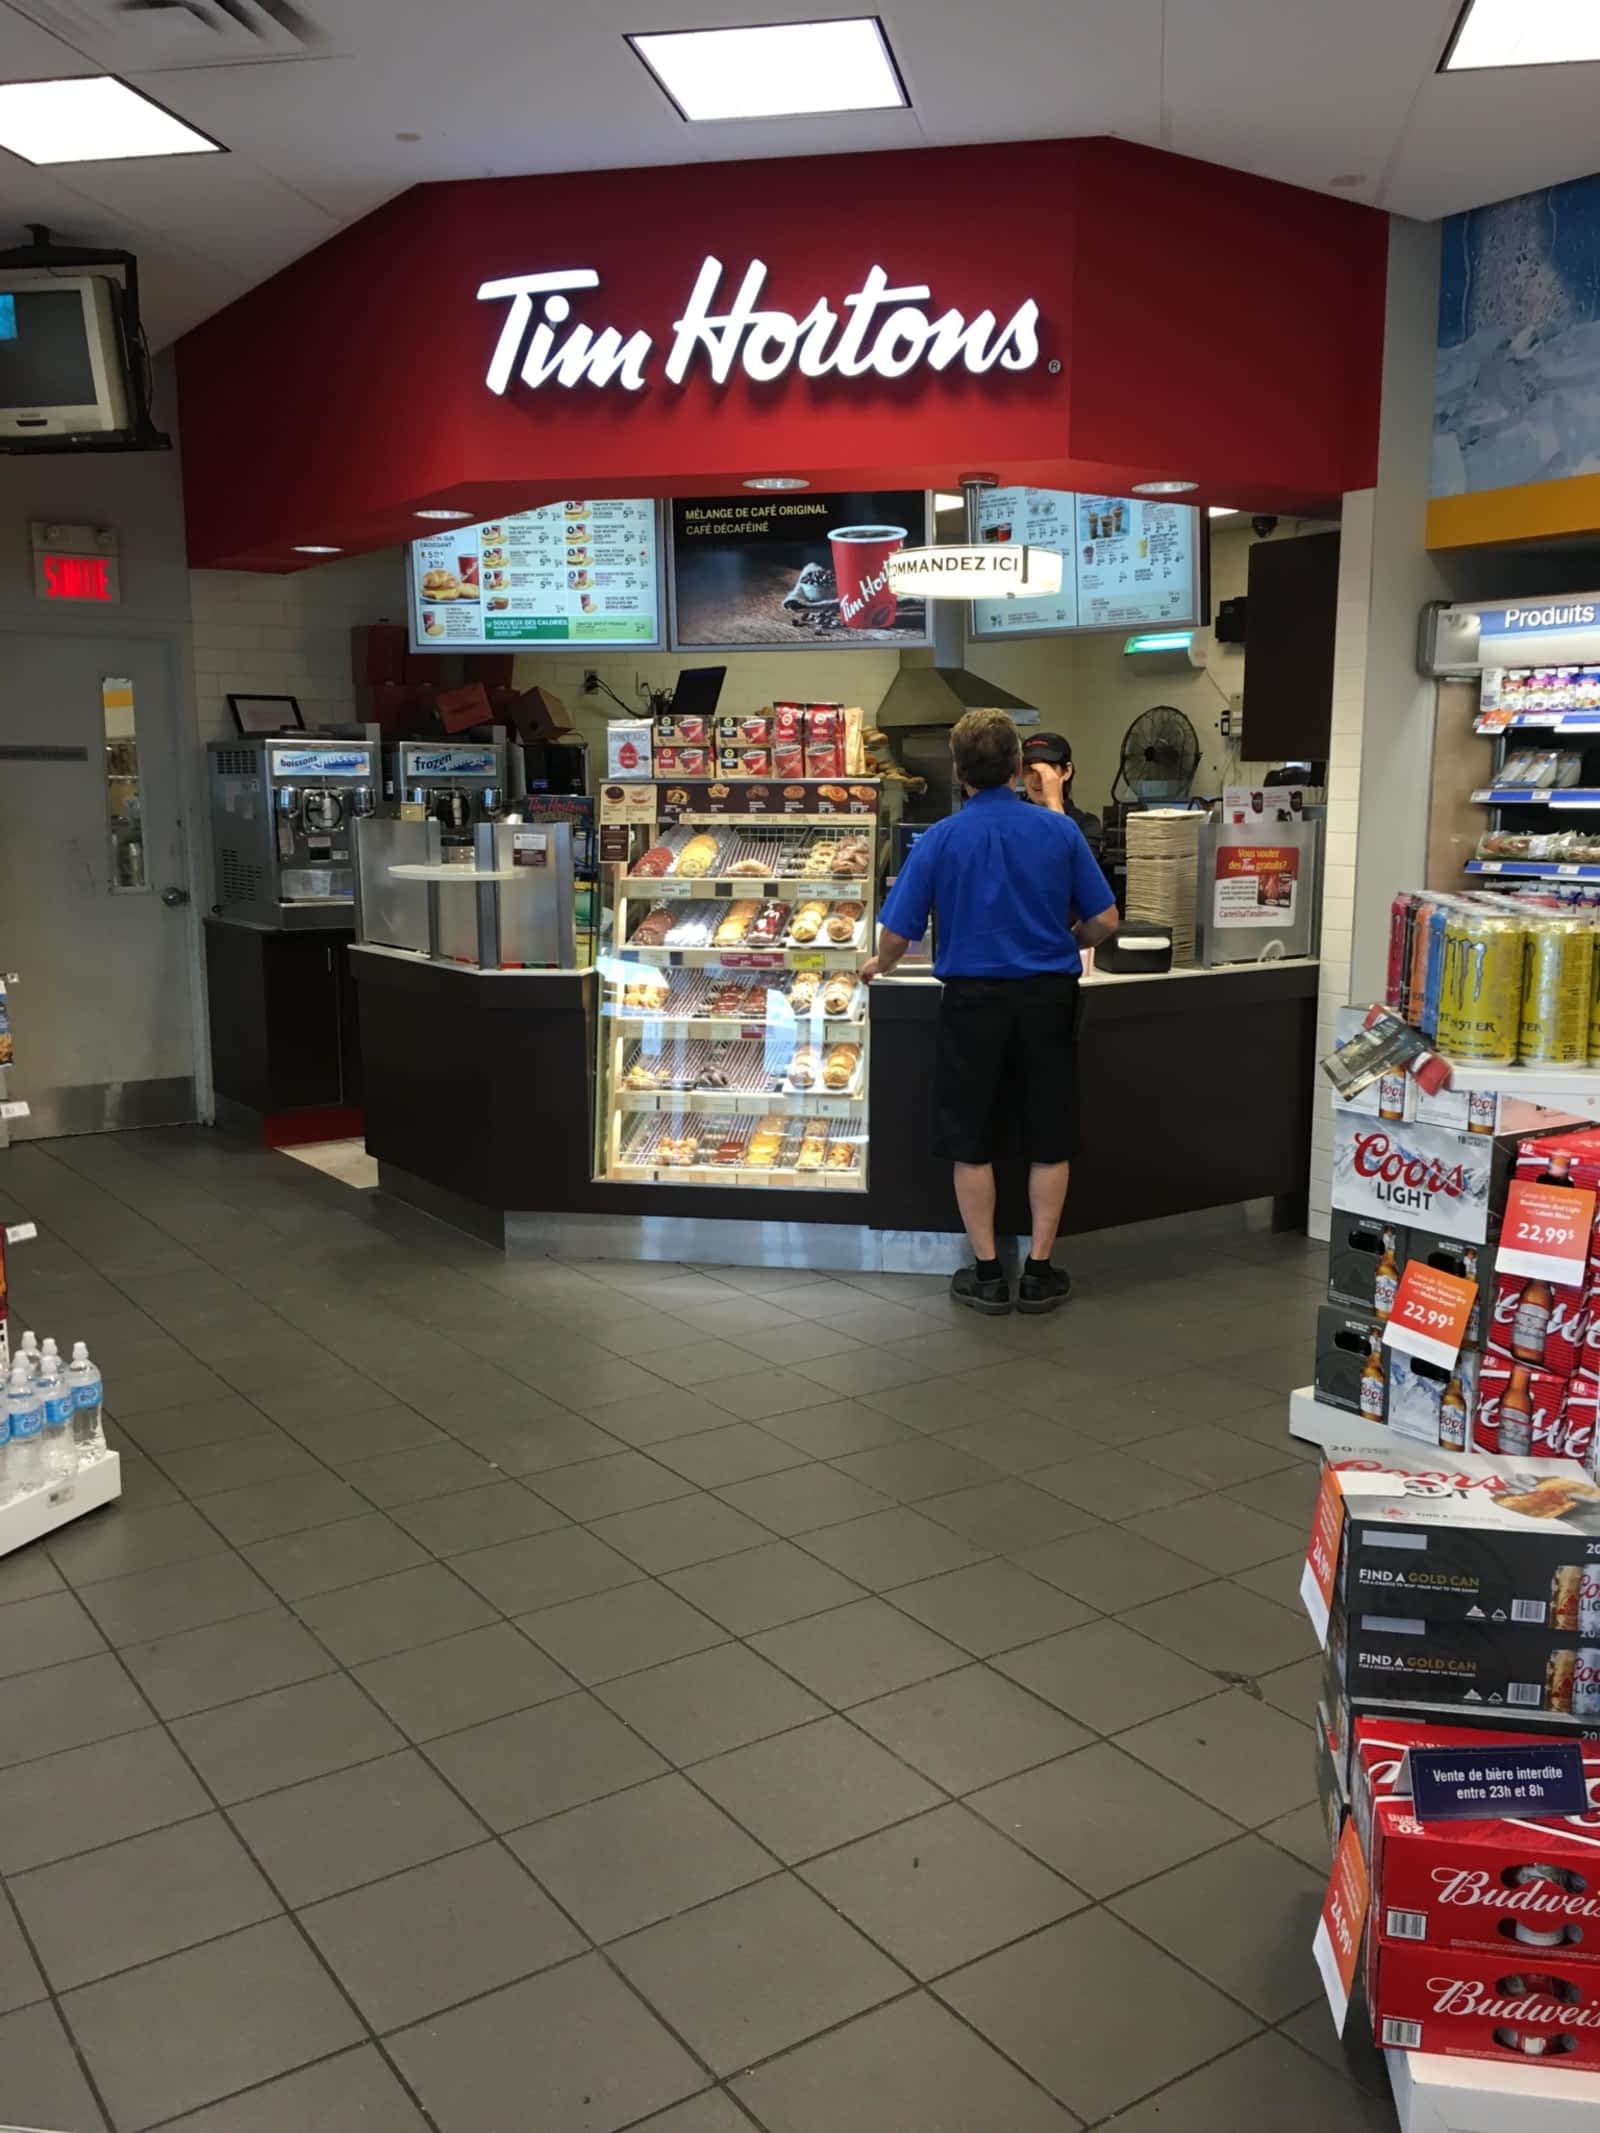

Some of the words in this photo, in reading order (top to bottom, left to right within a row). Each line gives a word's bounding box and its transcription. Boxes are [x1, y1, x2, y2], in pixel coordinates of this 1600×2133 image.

[476, 268, 652, 396] Tim
[664, 255, 1040, 384] Hortons
[685, 506, 733, 520] MÉLANGE
[735, 507, 749, 518] DE
[750, 504, 777, 517] CAFÉ
[779, 504, 829, 515] ORIGINAL
[686, 523, 712, 535] CAFÉ
[713, 521, 769, 534] DÉCAFÉINÉ
[993, 557, 1018, 571] ICI
[840, 594, 864, 622] Tim
[1504, 604, 1595, 628] Produits
[414, 754, 452, 771] frozen
[1353, 1132, 1466, 1197] Coors
[1376, 1182, 1432, 1211] LIGHT
[1516, 1222, 1576, 1245] 22,99$
[1402, 1301, 1455, 1329] 22,99$
[1359, 1569, 1393, 1582] FIND
[1395, 1572, 1406, 1583] A
[1408, 1572, 1446, 1585] GOLD
[1450, 1575, 1480, 1587] CAN
[1359, 1653, 1392, 1666] FIND
[1394, 1657, 1405, 1668] A
[1407, 1657, 1445, 1669] GOLD
[1448, 1660, 1477, 1671] CAN
[1433, 1769, 1465, 1782] Vente
[1468, 1768, 1482, 1781] de
[1485, 1767, 1514, 1780] bière
[1516, 1765, 1563, 1780] interdite
[1456, 1787, 1486, 1799] entre
[1489, 1785, 1511, 1798] 23h
[1514, 1786, 1526, 1797] et
[1529, 1784, 1544, 1797] 8h
[1431, 1866, 1600, 1918] Budwei
[1426, 1976, 1600, 2028] Budweis
